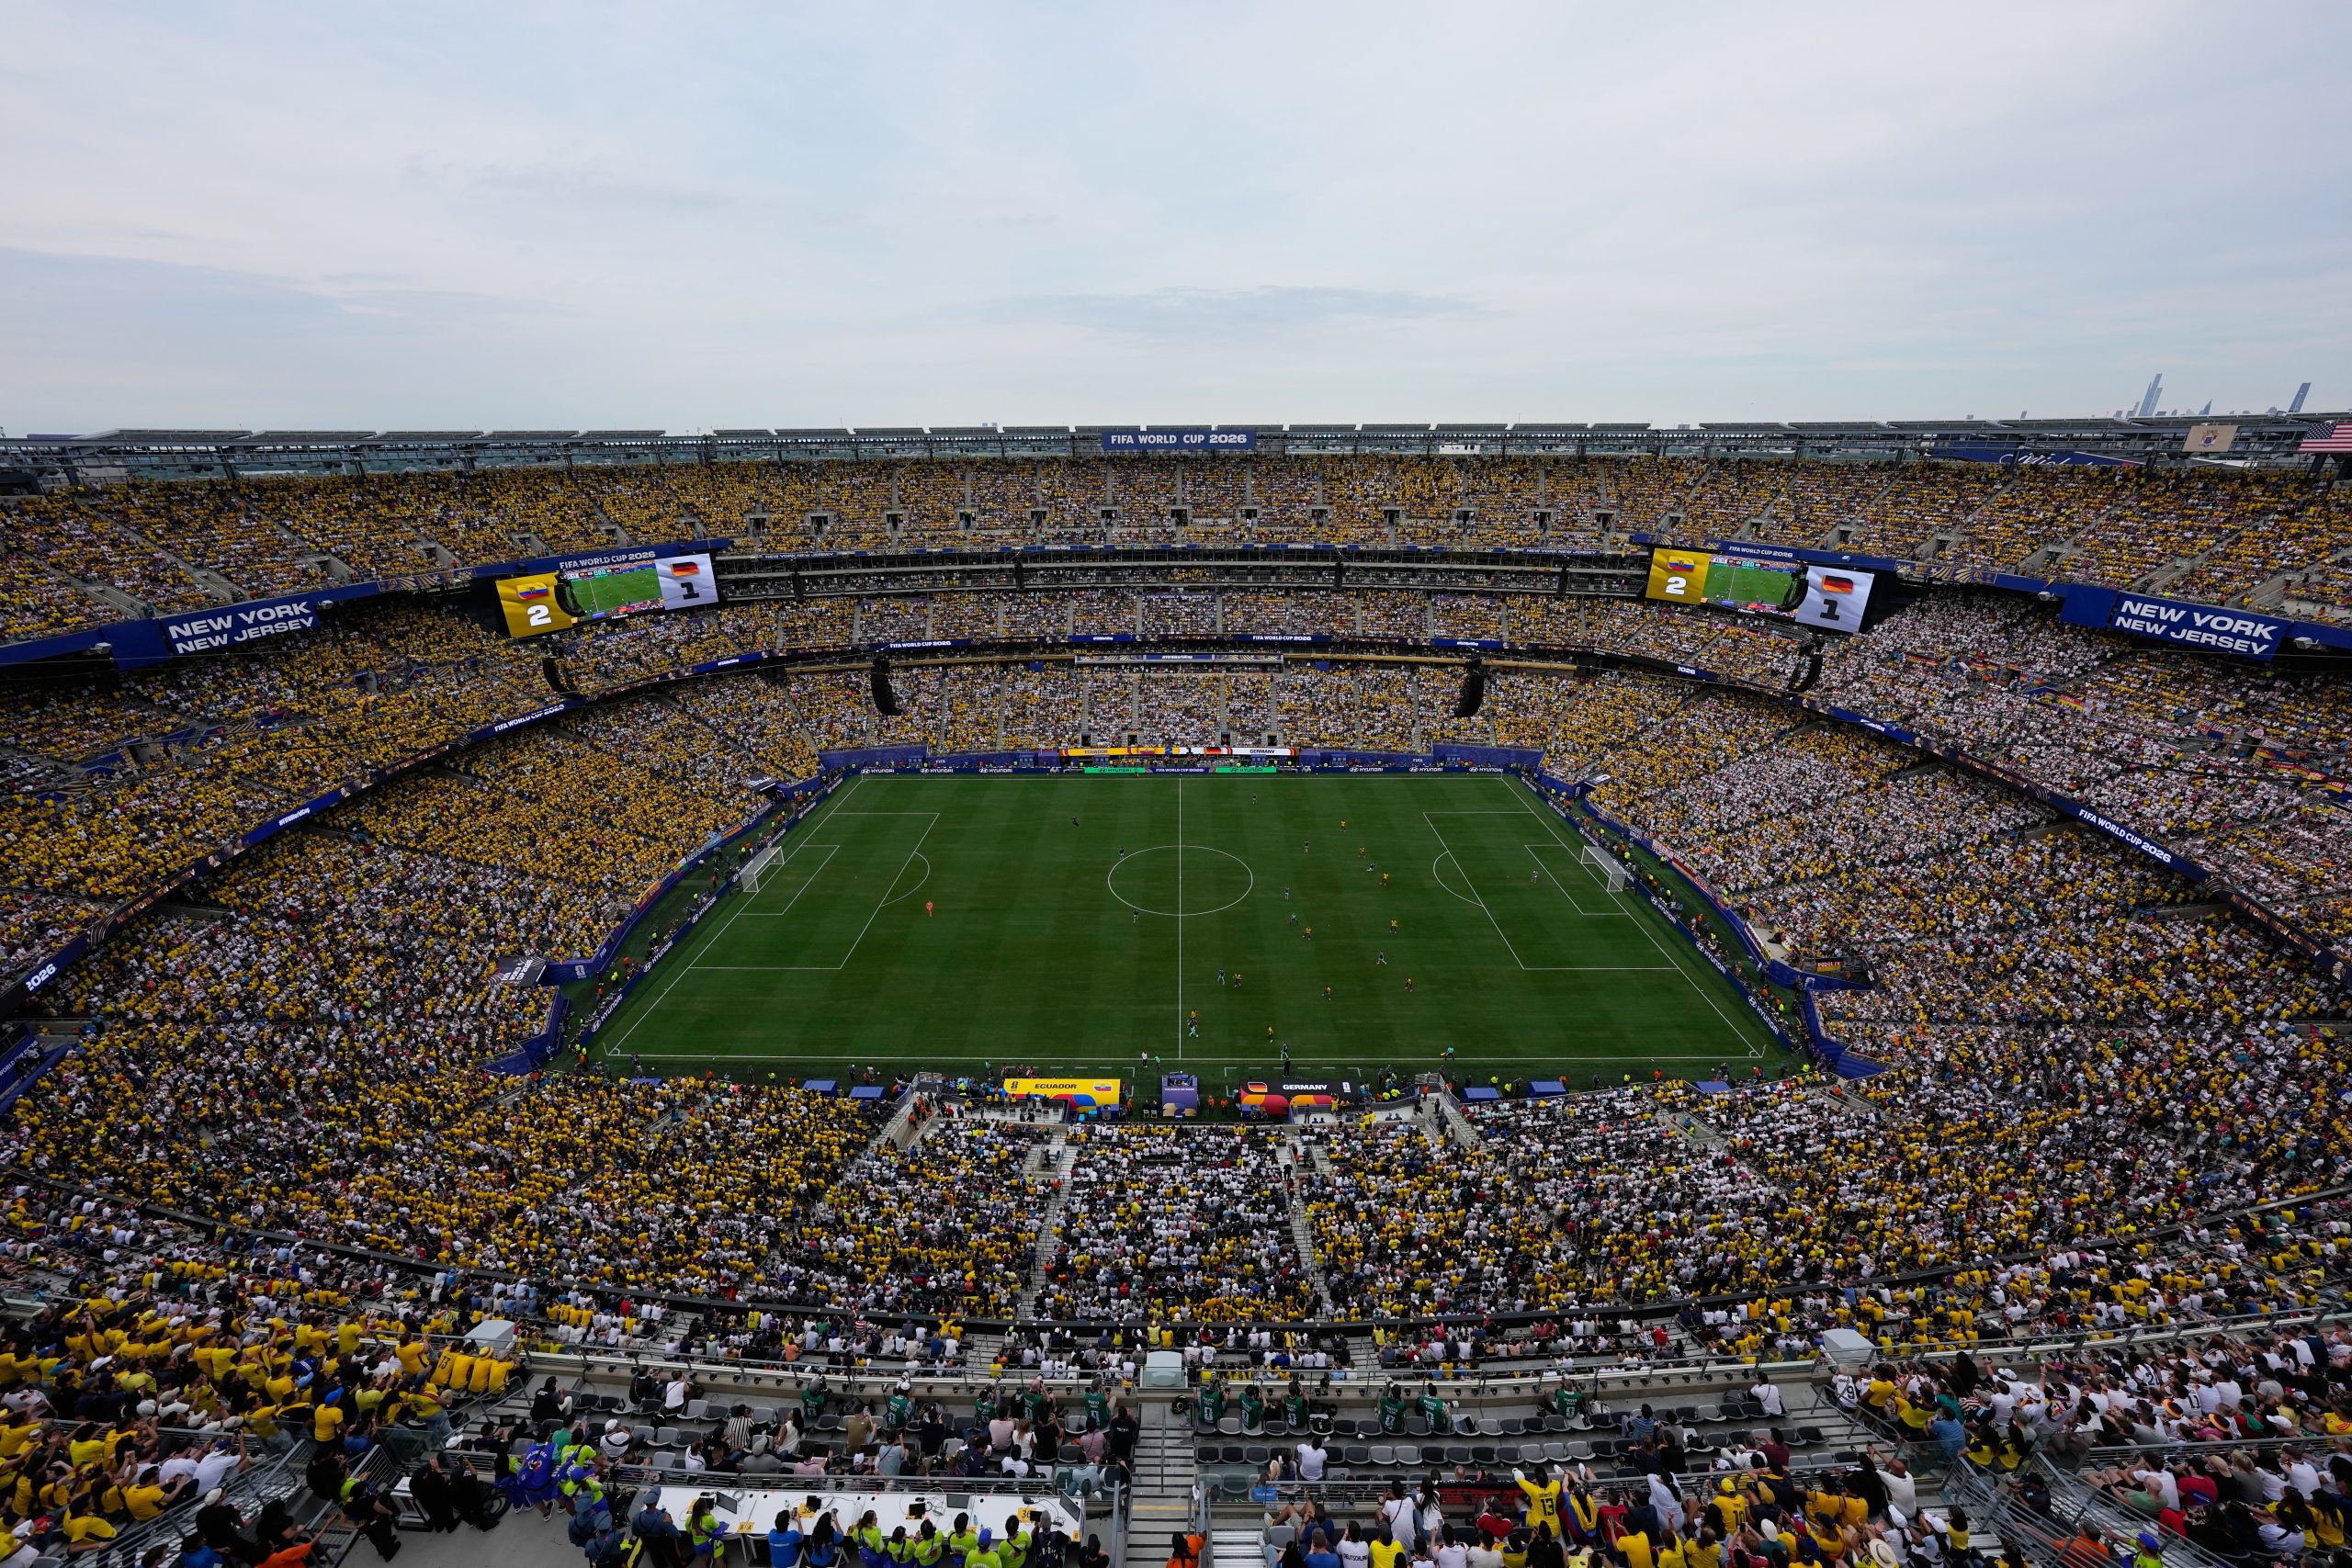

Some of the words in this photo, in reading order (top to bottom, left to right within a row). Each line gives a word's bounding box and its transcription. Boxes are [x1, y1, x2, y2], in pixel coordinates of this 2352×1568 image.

[1111, 434, 1134, 444] FIFA
[1138, 434, 1177, 444] WORLD
[1183, 434, 1205, 443] CUP
[1209, 434, 1247, 443] 2026
[559, 561, 579, 569] FIFA
[579, 557, 610, 567] WORLD
[611, 554, 627, 563] CUP
[628, 551, 656, 561] 2026
[679, 582, 700, 599] 1
[1665, 576, 1687, 595] 2
[169, 615, 232, 639] NEW
[238, 601, 311, 624] YORK
[526, 604, 552, 627] 2
[1820, 599, 1840, 622] 1
[2120, 600, 2187, 623] NEW
[2193, 612, 2278, 640] YORK
[176, 634, 228, 654] NEW
[234, 617, 314, 642] JERSEY
[2115, 617, 2167, 635] NEW
[2170, 629, 2269, 655] JERSEY
[494, 723, 509, 732] FIFA
[508, 716, 531, 727] WORLD
[2079, 809, 2097, 823] FIFA
[2098, 817, 2125, 837] WORLD
[2125, 833, 2142, 845] CUP
[2141, 842, 2172, 863] 2026
[687, 846, 705, 863] NEUSS
[699, 896, 716, 916] HYUNDAI
[1658, 904, 1676, 924] HYUNDAI
[652, 940, 673, 964] HYUNDAI
[1704, 950, 1726, 974] HYUNDAI
[26, 963, 57, 991] 2026
[601, 994, 623, 1022] HYUNDAI
[1756, 1005, 1779, 1035] HYUNDAI
[1847, 1385, 1855, 1399] 9
[1541, 1498, 1554, 1516] 13
